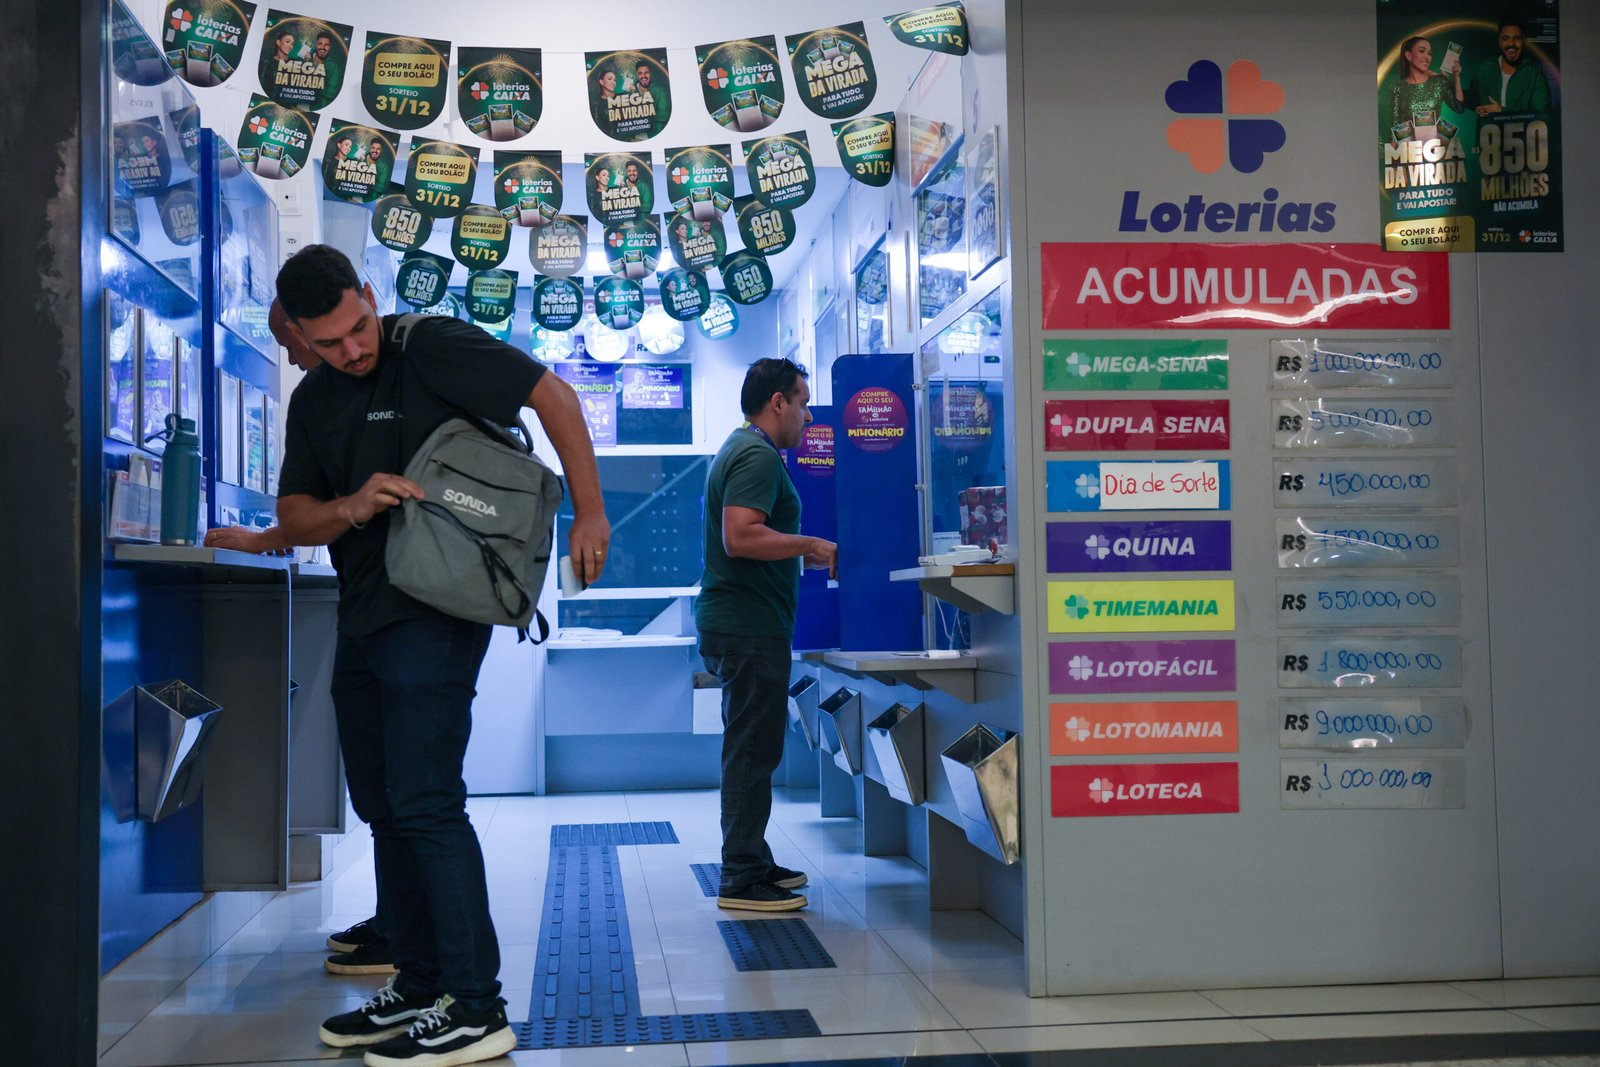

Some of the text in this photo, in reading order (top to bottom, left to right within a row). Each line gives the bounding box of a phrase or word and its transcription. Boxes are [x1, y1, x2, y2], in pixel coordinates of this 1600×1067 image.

[198, 15, 242, 35] loterias
[902, 11, 954, 26] COMPRE AQUI
[929, 15, 957, 25] BOLÃO!
[195, 26, 238, 46] CAIXA
[913, 32, 963, 47] 31/12
[278, 59, 326, 77] MEGA
[732, 63, 773, 75] loterias
[804, 52, 864, 80] MEGA
[275, 73, 324, 89] DA VIRADA
[404, 70, 434, 79] BOLÃO!
[734, 72, 775, 86] CAIXA
[493, 82, 529, 91] loterias
[808, 69, 868, 97] DA VIRADA
[389, 88, 418, 96] SORTEIO
[493, 92, 530, 100] CAIXA
[607, 91, 654, 108] MEGA
[822, 88, 861, 103] PARA TUDO
[376, 96, 431, 116] 31/12
[608, 102, 656, 122] DA VIRADA
[272, 122, 308, 140] loterias
[269, 132, 304, 149] CAIXA
[847, 134, 872, 145] COMPRE
[868, 136, 889, 147] BOLÃO!
[1385, 138, 1466, 164] MEGA
[1480, 121, 1548, 175] 850
[338, 160, 377, 173] MEGA
[440, 169, 465, 177] BOLÃO!
[693, 166, 727, 174] loterias
[757, 155, 806, 179] MEGA
[856, 161, 891, 174] 31/12
[1385, 160, 1467, 189] DA VIRADA
[335, 170, 376, 185] DA VIRADA
[693, 174, 728, 183] CAIXA
[760, 170, 809, 192] DA VIRADA
[427, 182, 451, 191] SORTEIO
[602, 186, 639, 200] MEGA
[786, 185, 802, 194] TUDO
[1481, 172, 1548, 200] MILHÕES
[416, 189, 460, 207] 31/12
[1400, 189, 1453, 200] PARA TUDO
[602, 198, 640, 211] DA VIRADA
[1118, 188, 1336, 233] Loterias
[1417, 199, 1456, 208] APOSTAR!
[1494, 200, 1538, 212] NÃO ACUMULA
[386, 207, 422, 233] 850
[750, 209, 783, 238] 850
[382, 228, 415, 244] MILHÕES
[1400, 226, 1459, 237] COMPRE AQUI
[1428, 235, 1460, 244] BOLÃO!
[1482, 233, 1511, 242] 31/12
[538, 236, 581, 247] MEGA
[460, 245, 498, 261] 31/12
[538, 247, 581, 258] DA VIRADA
[408, 270, 438, 292] 850
[734, 265, 762, 291] 850
[1076, 266, 1418, 305] ACUMULADAS
[541, 294, 577, 304] MEGA
[541, 303, 577, 315] DA VIRADA
[1093, 357, 1208, 372] MEGA-SENA
[1277, 356, 1302, 372] R$
[367, 410, 403, 421] SOND
[848, 426, 904, 437] MILIONÁRIO
[1075, 416, 1226, 433] DUPLA SENA
[1278, 415, 1302, 433] R$
[1105, 472, 1217, 495] Dia de Sorte
[1279, 473, 1430, 496] R$ 450.000,00
[443, 489, 497, 517] SONDA
[1112, 537, 1195, 558] QUINA
[1282, 534, 1306, 551] R$
[1094, 600, 1218, 616] TIMEMANIA
[1282, 594, 1307, 611] R$
[1096, 656, 1217, 677] LOTOFÁCIL
[1284, 655, 1308, 672] R$
[1094, 722, 1223, 738] LOTOMANIA
[1284, 714, 1309, 732] R$
[1116, 783, 1202, 800] LOTECA
[1286, 775, 1312, 793] R$
